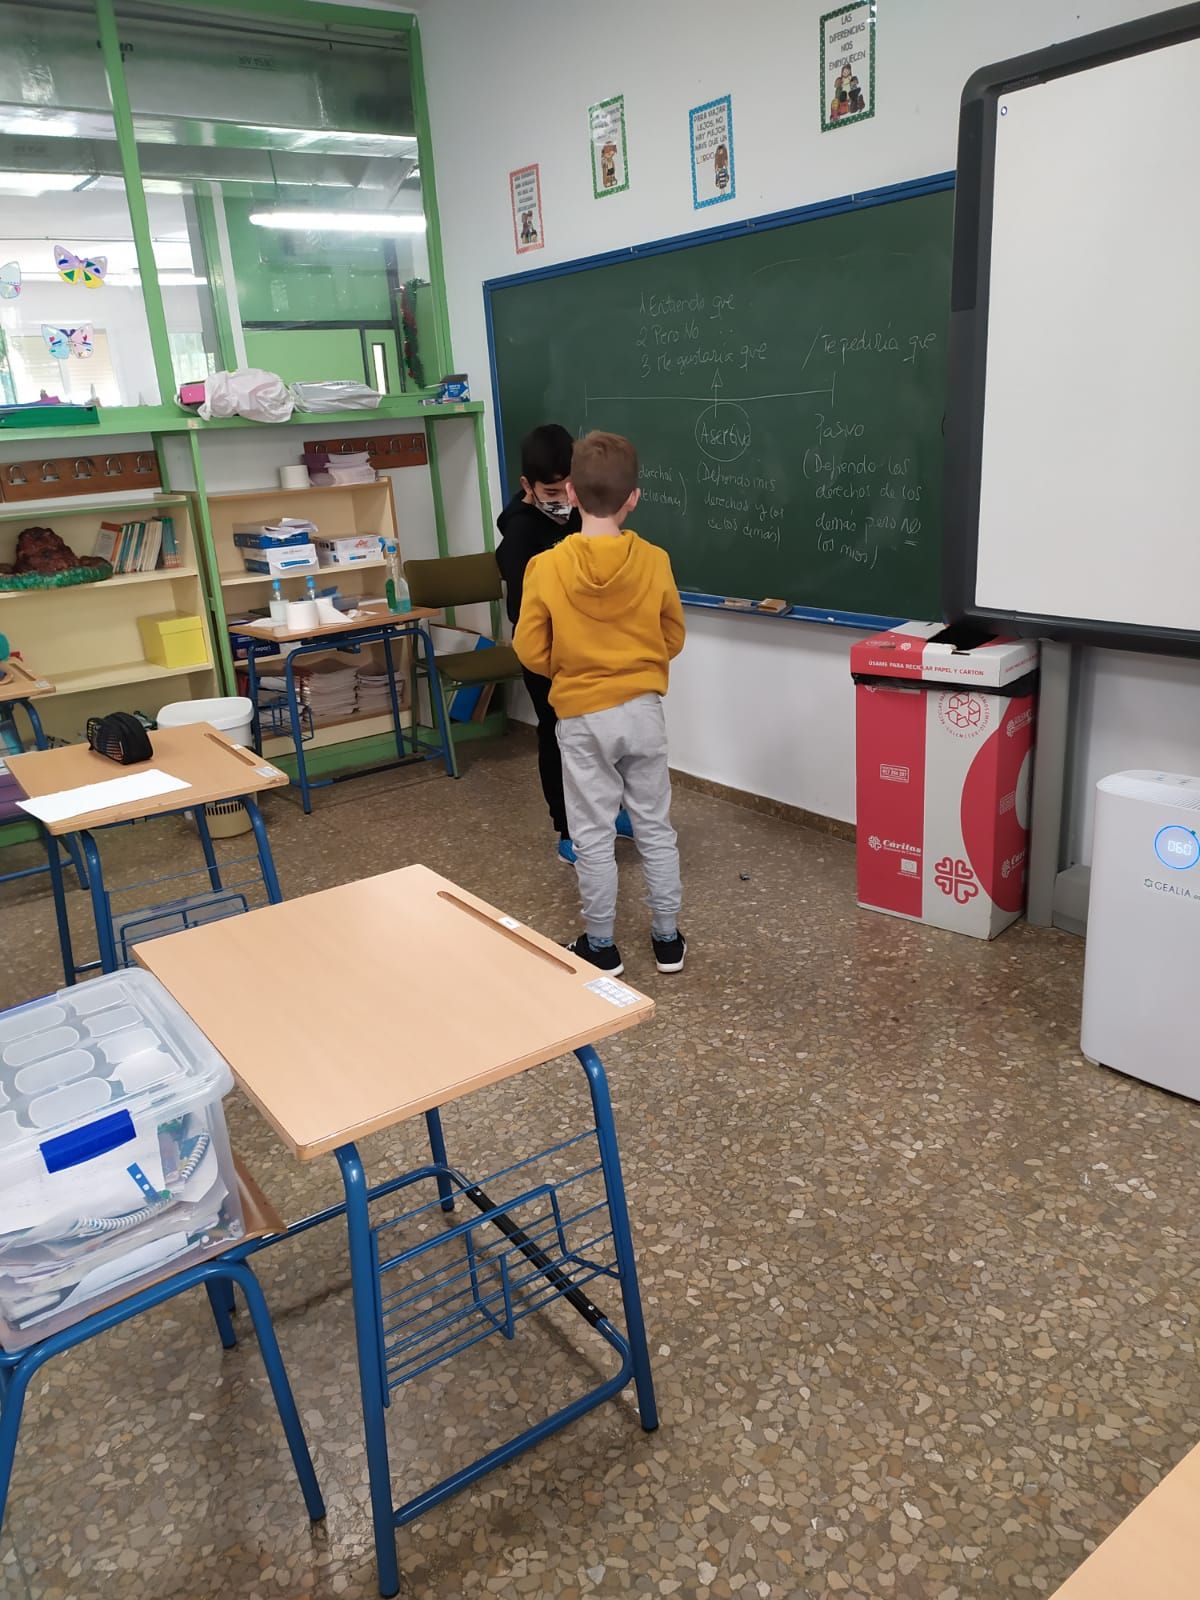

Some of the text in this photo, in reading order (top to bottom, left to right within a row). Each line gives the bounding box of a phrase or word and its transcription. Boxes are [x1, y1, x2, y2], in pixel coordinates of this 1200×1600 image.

[841, 13, 852, 26] LAS
[829, 22, 866, 44] DIFERENCIAS
[840, 40, 854, 52] NOS
[829, 50, 866, 71] ENRIQUECEN
[715, 116, 724, 124] NO
[707, 126, 726, 137] MEJOR
[710, 294, 736, 320] que
[652, 324, 680, 345] Pero
[902, 332, 937, 365] que
[640, 353, 651, 378] 3
[740, 342, 768, 372] que
[814, 413, 865, 445] Pasivo
[888, 455, 911, 476] los
[704, 488, 749, 512] derechos
[815, 482, 922, 502] derechos de los
[817, 534, 834, 552] los
[889, 662, 904, 670] PARA
[905, 664, 933, 672] RECICLAR
[934, 666, 952, 674] PAPEL
